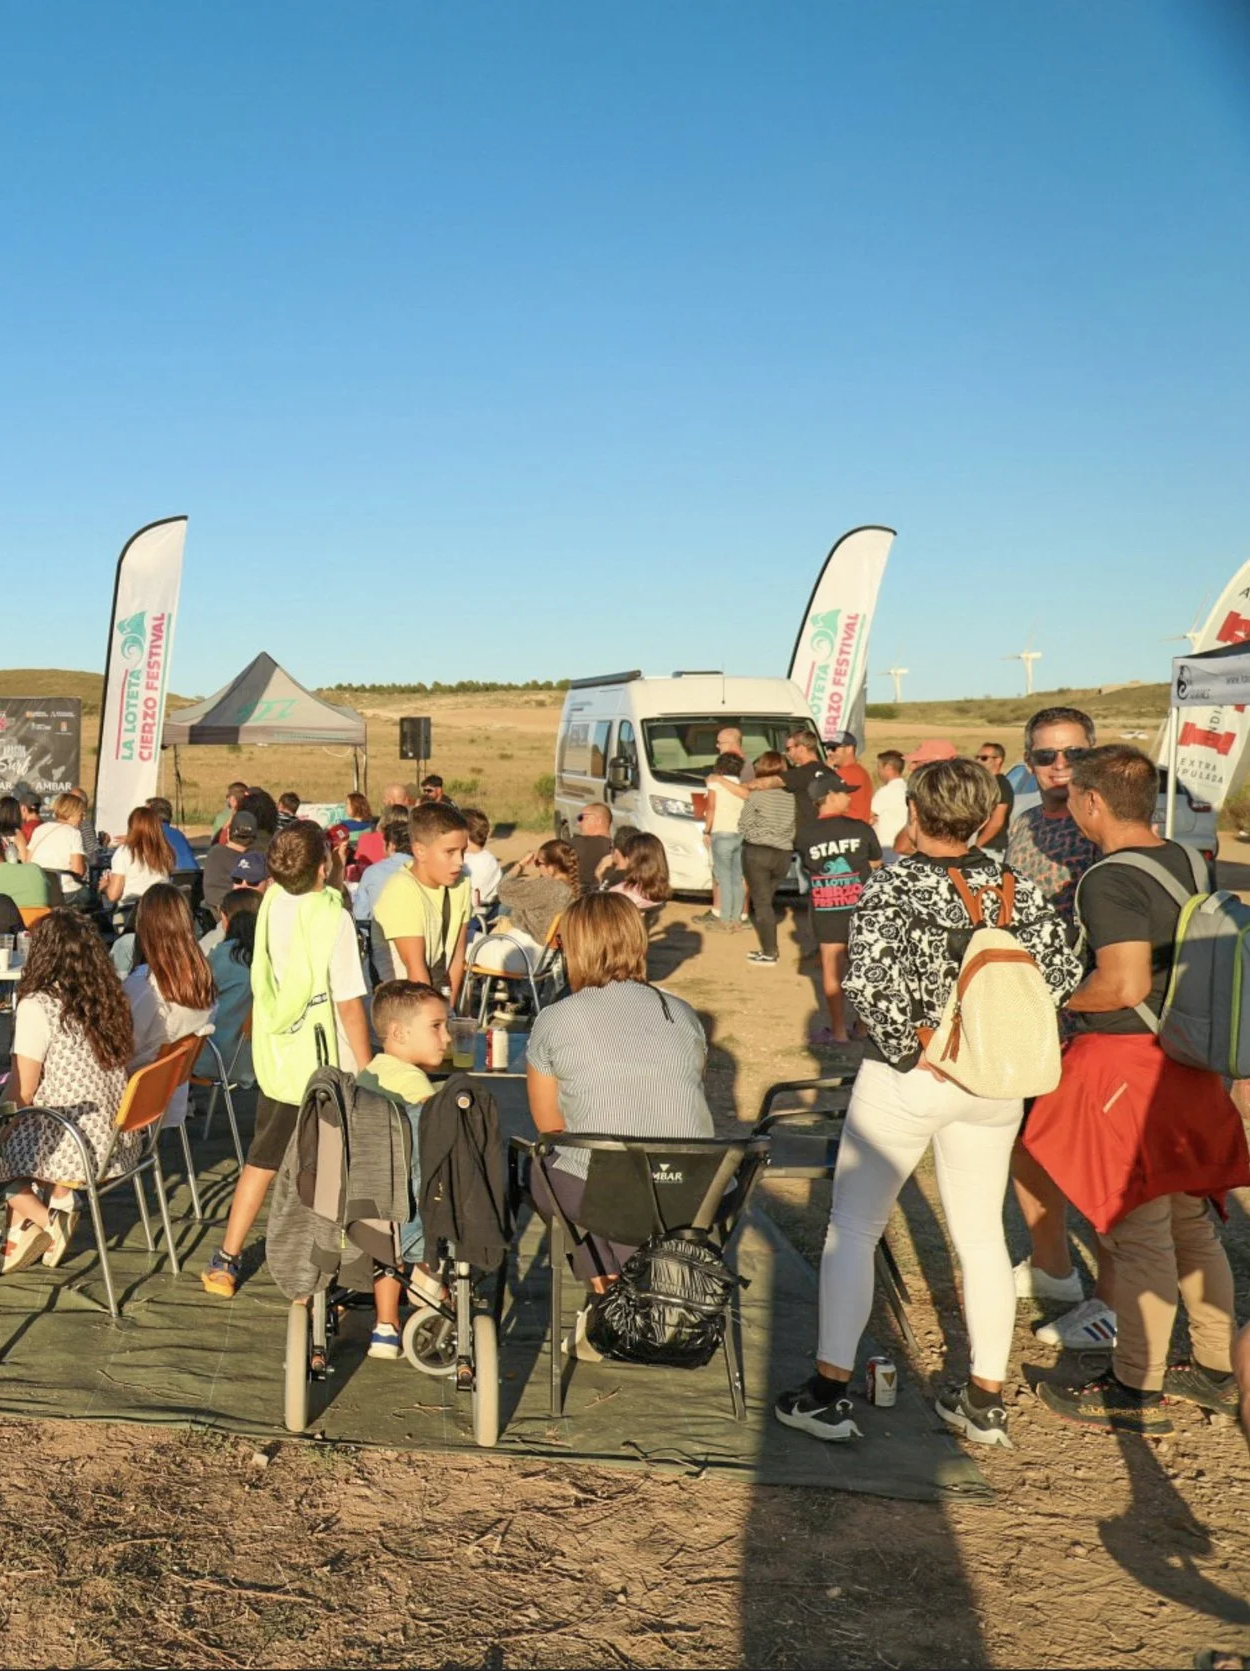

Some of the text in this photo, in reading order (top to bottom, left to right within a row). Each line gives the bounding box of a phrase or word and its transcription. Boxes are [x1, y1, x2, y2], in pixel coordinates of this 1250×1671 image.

[832, 613, 860, 687] FESTIVAL
[138, 612, 166, 762] CIERZO FESTIVAL
[810, 664, 830, 718] OTETA
[122, 668, 142, 761] LA LOTETA
[1181, 757, 1217, 772] EXTRA
[35, 781, 72, 791] AMBAR
[809, 838, 861, 860] STAFF
[811, 879, 823, 888] LA
[652, 1172, 683, 1181] MBAR
